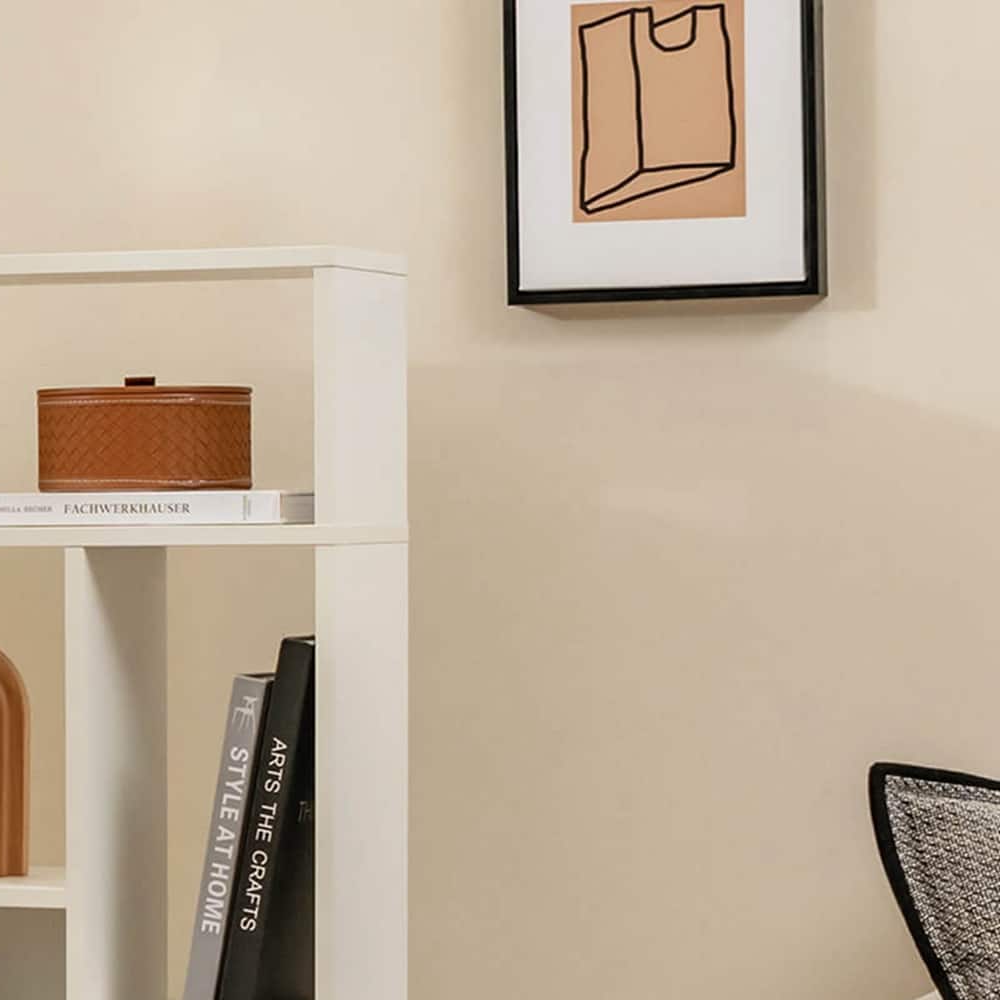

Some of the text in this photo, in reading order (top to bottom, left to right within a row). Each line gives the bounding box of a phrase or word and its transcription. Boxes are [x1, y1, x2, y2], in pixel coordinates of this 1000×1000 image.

[63, 502, 191, 516] FACHWERKHAUSER
[219, 746, 249, 821] STYLE
[215, 825, 237, 860] AT
[240, 737, 288, 933] ARTS THE CRAFTS
[201, 864, 230, 935] HOME
